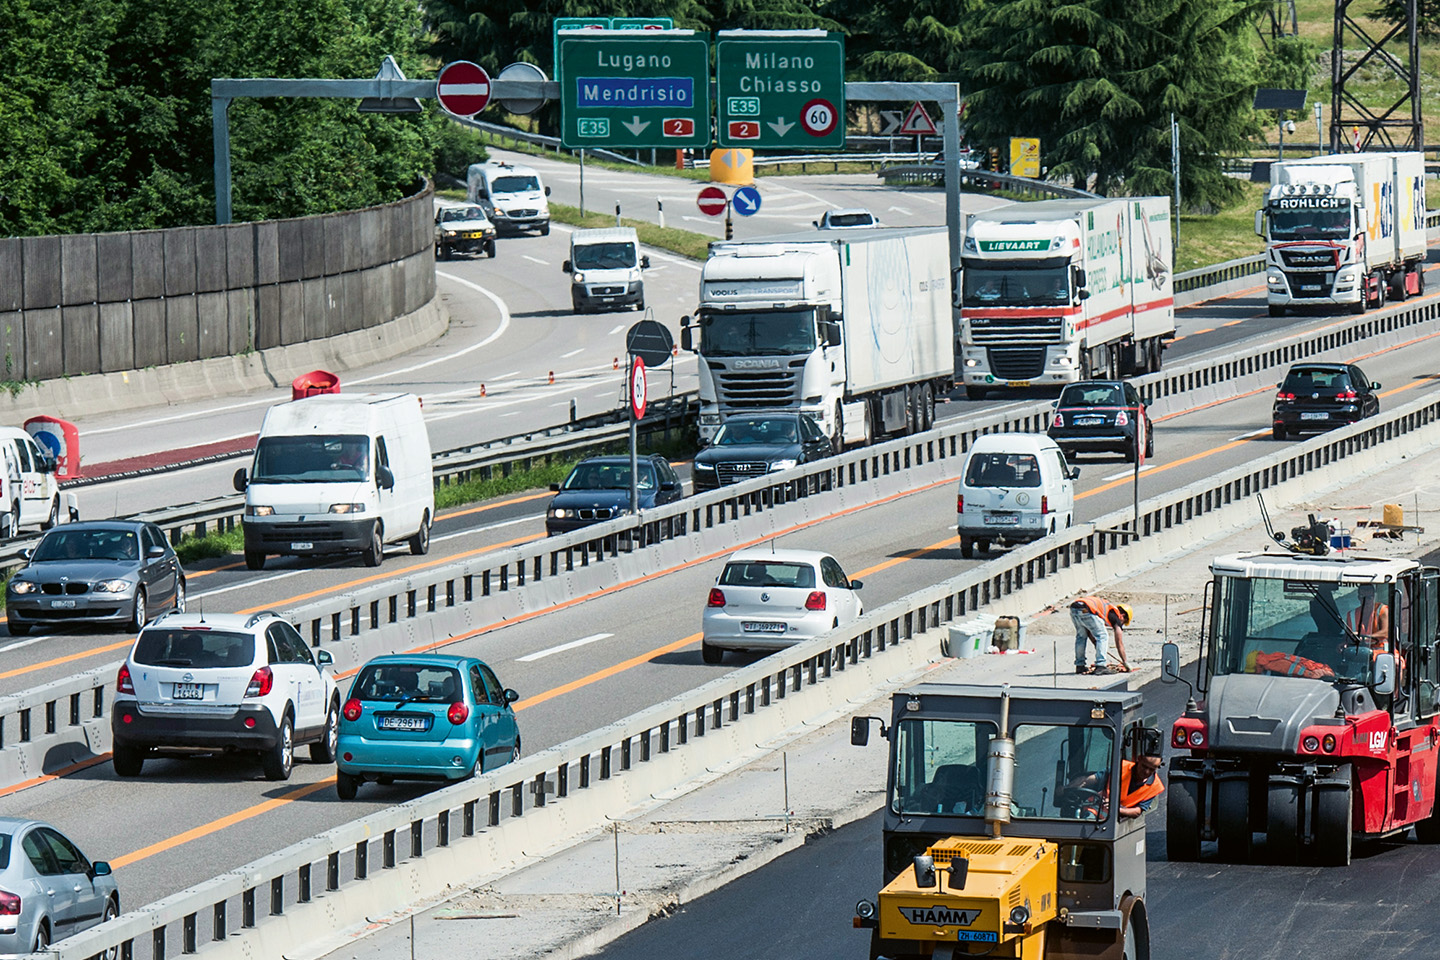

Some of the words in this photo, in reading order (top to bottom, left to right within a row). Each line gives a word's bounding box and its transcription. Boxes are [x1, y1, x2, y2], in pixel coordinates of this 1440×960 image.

[598, 51, 672, 71] Lugano
[745, 53, 814, 69] Milano
[740, 76, 822, 93] Chiasso
[584, 85, 687, 101] Mendrisio
[730, 101, 757, 113] E35
[810, 110, 827, 124] 60
[580, 121, 607, 134] E35
[673, 121, 684, 133] 2
[740, 124, 749, 136] 2
[1280, 198, 1339, 209] RÖHLICH
[989, 241, 1041, 251] LIEVAART
[735, 360, 780, 369] SCANIA
[1369, 731, 1388, 748] LGV
[912, 909, 968, 924] HAMM
